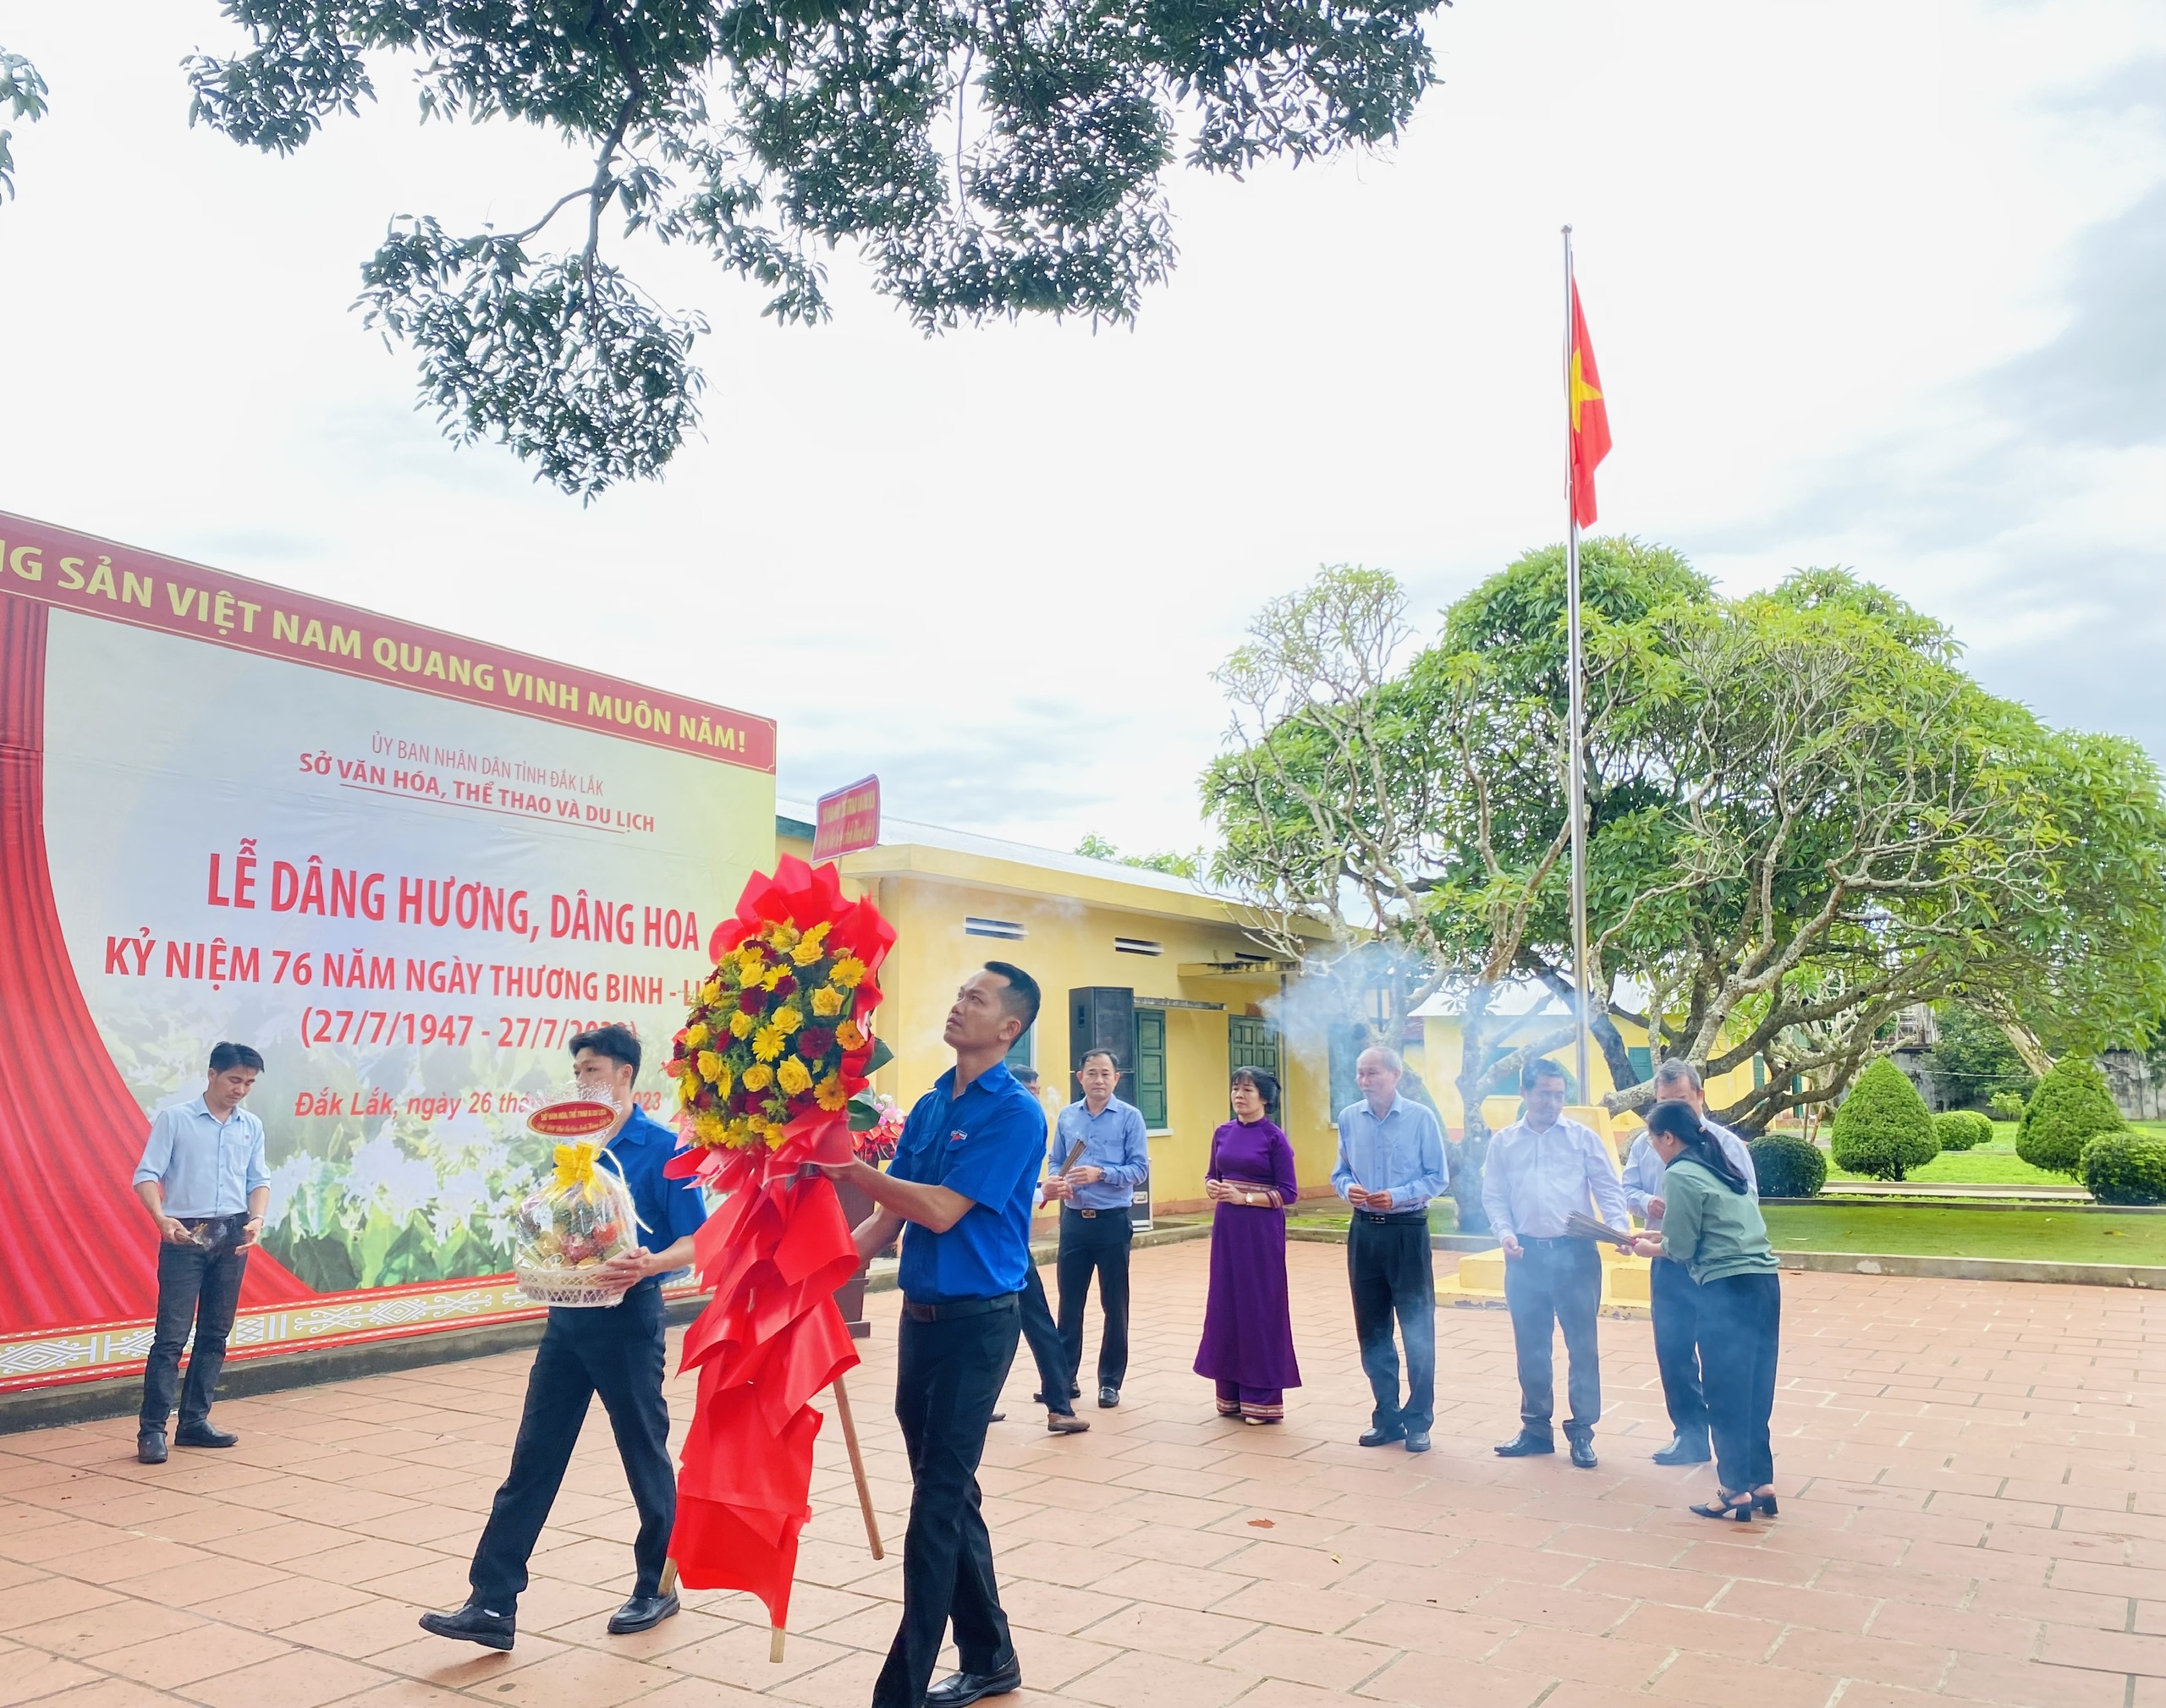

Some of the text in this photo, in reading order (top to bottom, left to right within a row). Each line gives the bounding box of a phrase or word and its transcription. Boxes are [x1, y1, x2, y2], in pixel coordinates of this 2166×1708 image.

[57, 555, 153, 609] SẢN
[166, 581, 261, 635] VIỆT
[272, 610, 362, 660] NAM
[371, 636, 495, 692] QUANG
[503, 668, 579, 712] VINH
[587, 691, 671, 735] MUÔN
[679, 715, 746, 754] NĂM!
[299, 750, 655, 833] SỞ VĂN HÓA, THỂ THAO VÀ DU LỊCH
[371, 730, 604, 797] ỦY BAN NHÂN DÂN TỈNH ĐẮK LẮK
[206, 838, 700, 952] LỄ DÂNG HƯƠNG, DÂNG HOA
[104, 926, 157, 976] KỶ
[165, 936, 260, 991] NIỆM
[272, 949, 313, 986] 76
[322, 947, 395, 991] NĂM
[405, 955, 483, 996] NGÀY
[489, 964, 598, 1002] THƯƠNG
[606, 974, 663, 1005] BINH
[300, 1006, 474, 1049] (27/7/1947
[294, 1086, 344, 1117] Đắk
[349, 1086, 399, 1120] Lắk,
[406, 1091, 462, 1121] ngày
[467, 1091, 492, 1114] 26
[633, 1090, 662, 1112] 023
